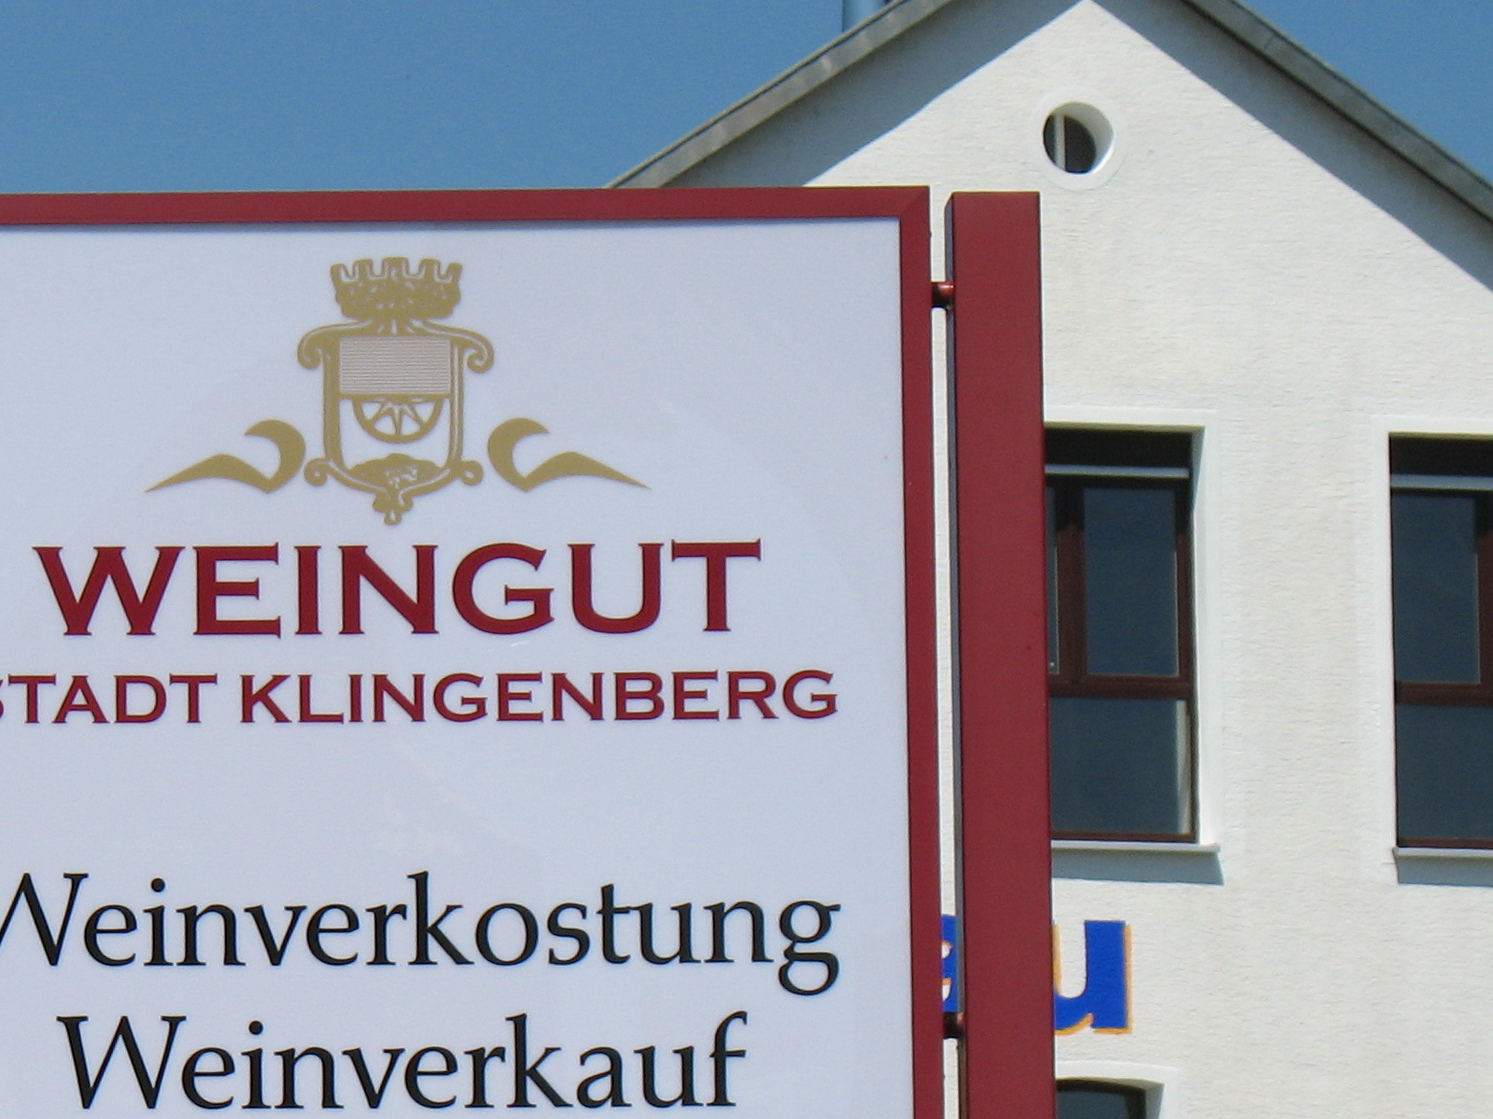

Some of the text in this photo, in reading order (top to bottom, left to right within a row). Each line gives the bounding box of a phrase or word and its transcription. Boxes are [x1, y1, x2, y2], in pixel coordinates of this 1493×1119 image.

[32, 538, 762, 639] WEINGUT
[240, 669, 838, 725] KLINGENBERG
[55, 1010, 748, 1111] Weinverkauf
